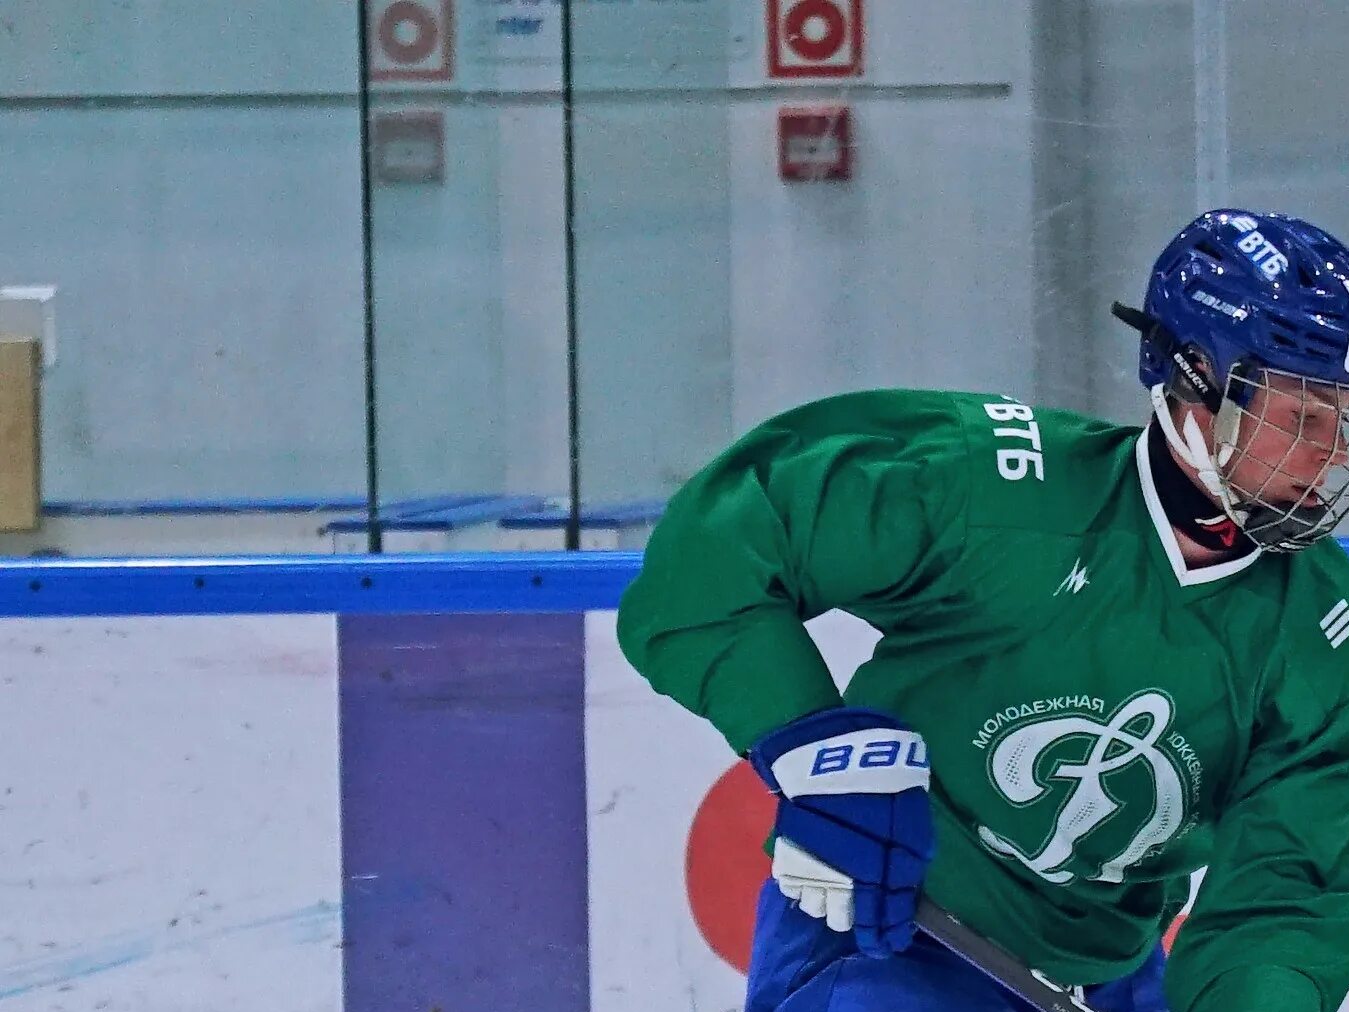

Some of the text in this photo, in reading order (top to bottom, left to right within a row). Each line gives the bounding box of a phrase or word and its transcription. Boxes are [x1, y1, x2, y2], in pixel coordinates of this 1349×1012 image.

[1238, 231, 1289, 281] ВТБ
[984, 404, 1044, 481] ВТБ
[972, 695, 1104, 749] МОЛОДЕЖНАЯ
